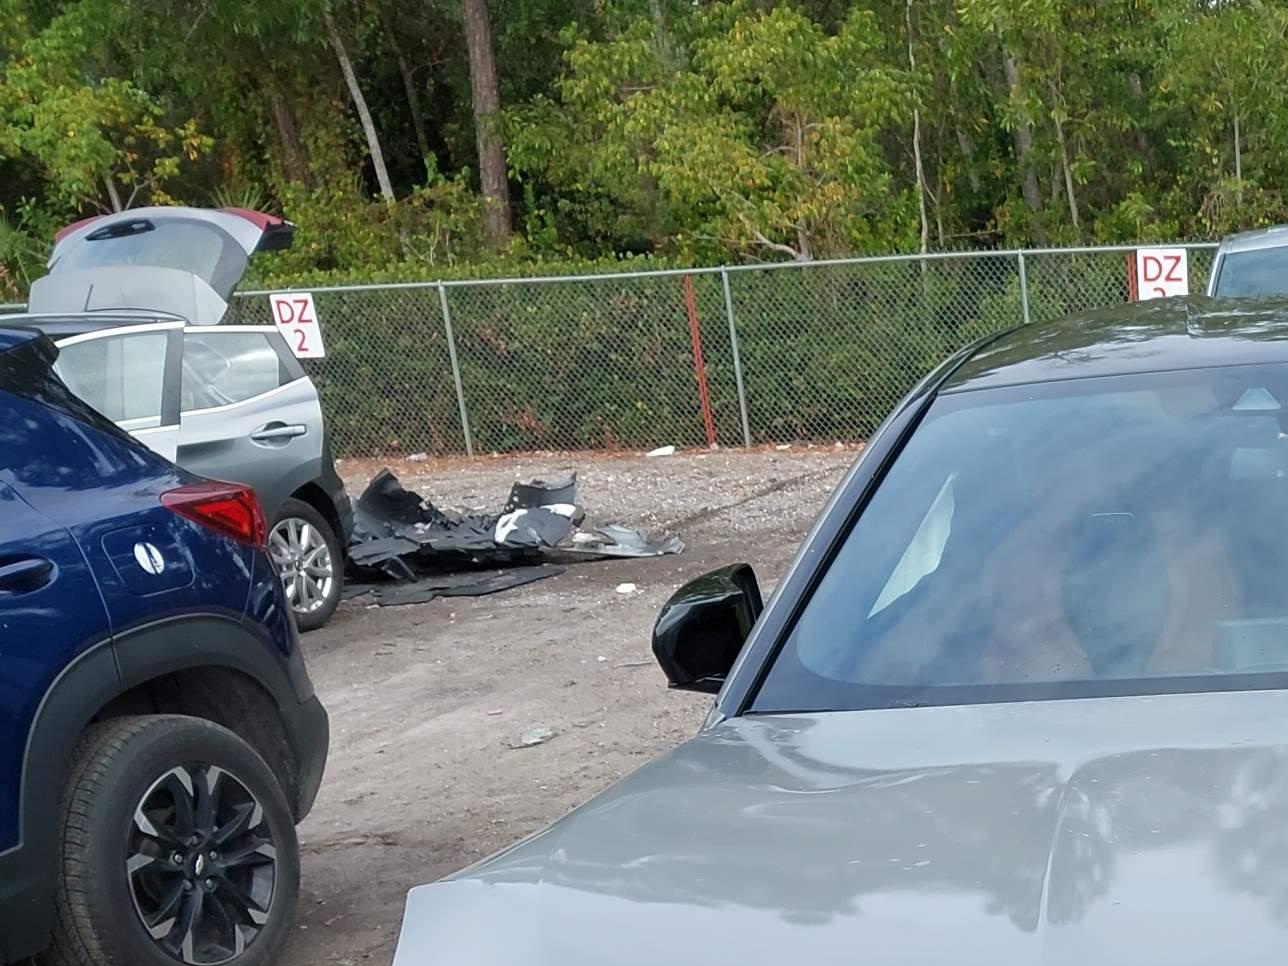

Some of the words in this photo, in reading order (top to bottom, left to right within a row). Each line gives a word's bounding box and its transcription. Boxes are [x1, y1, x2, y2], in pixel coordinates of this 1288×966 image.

[1143, 255, 1183, 282] DZ
[275, 299, 313, 325] DZ
[293, 329, 309, 352] 2
